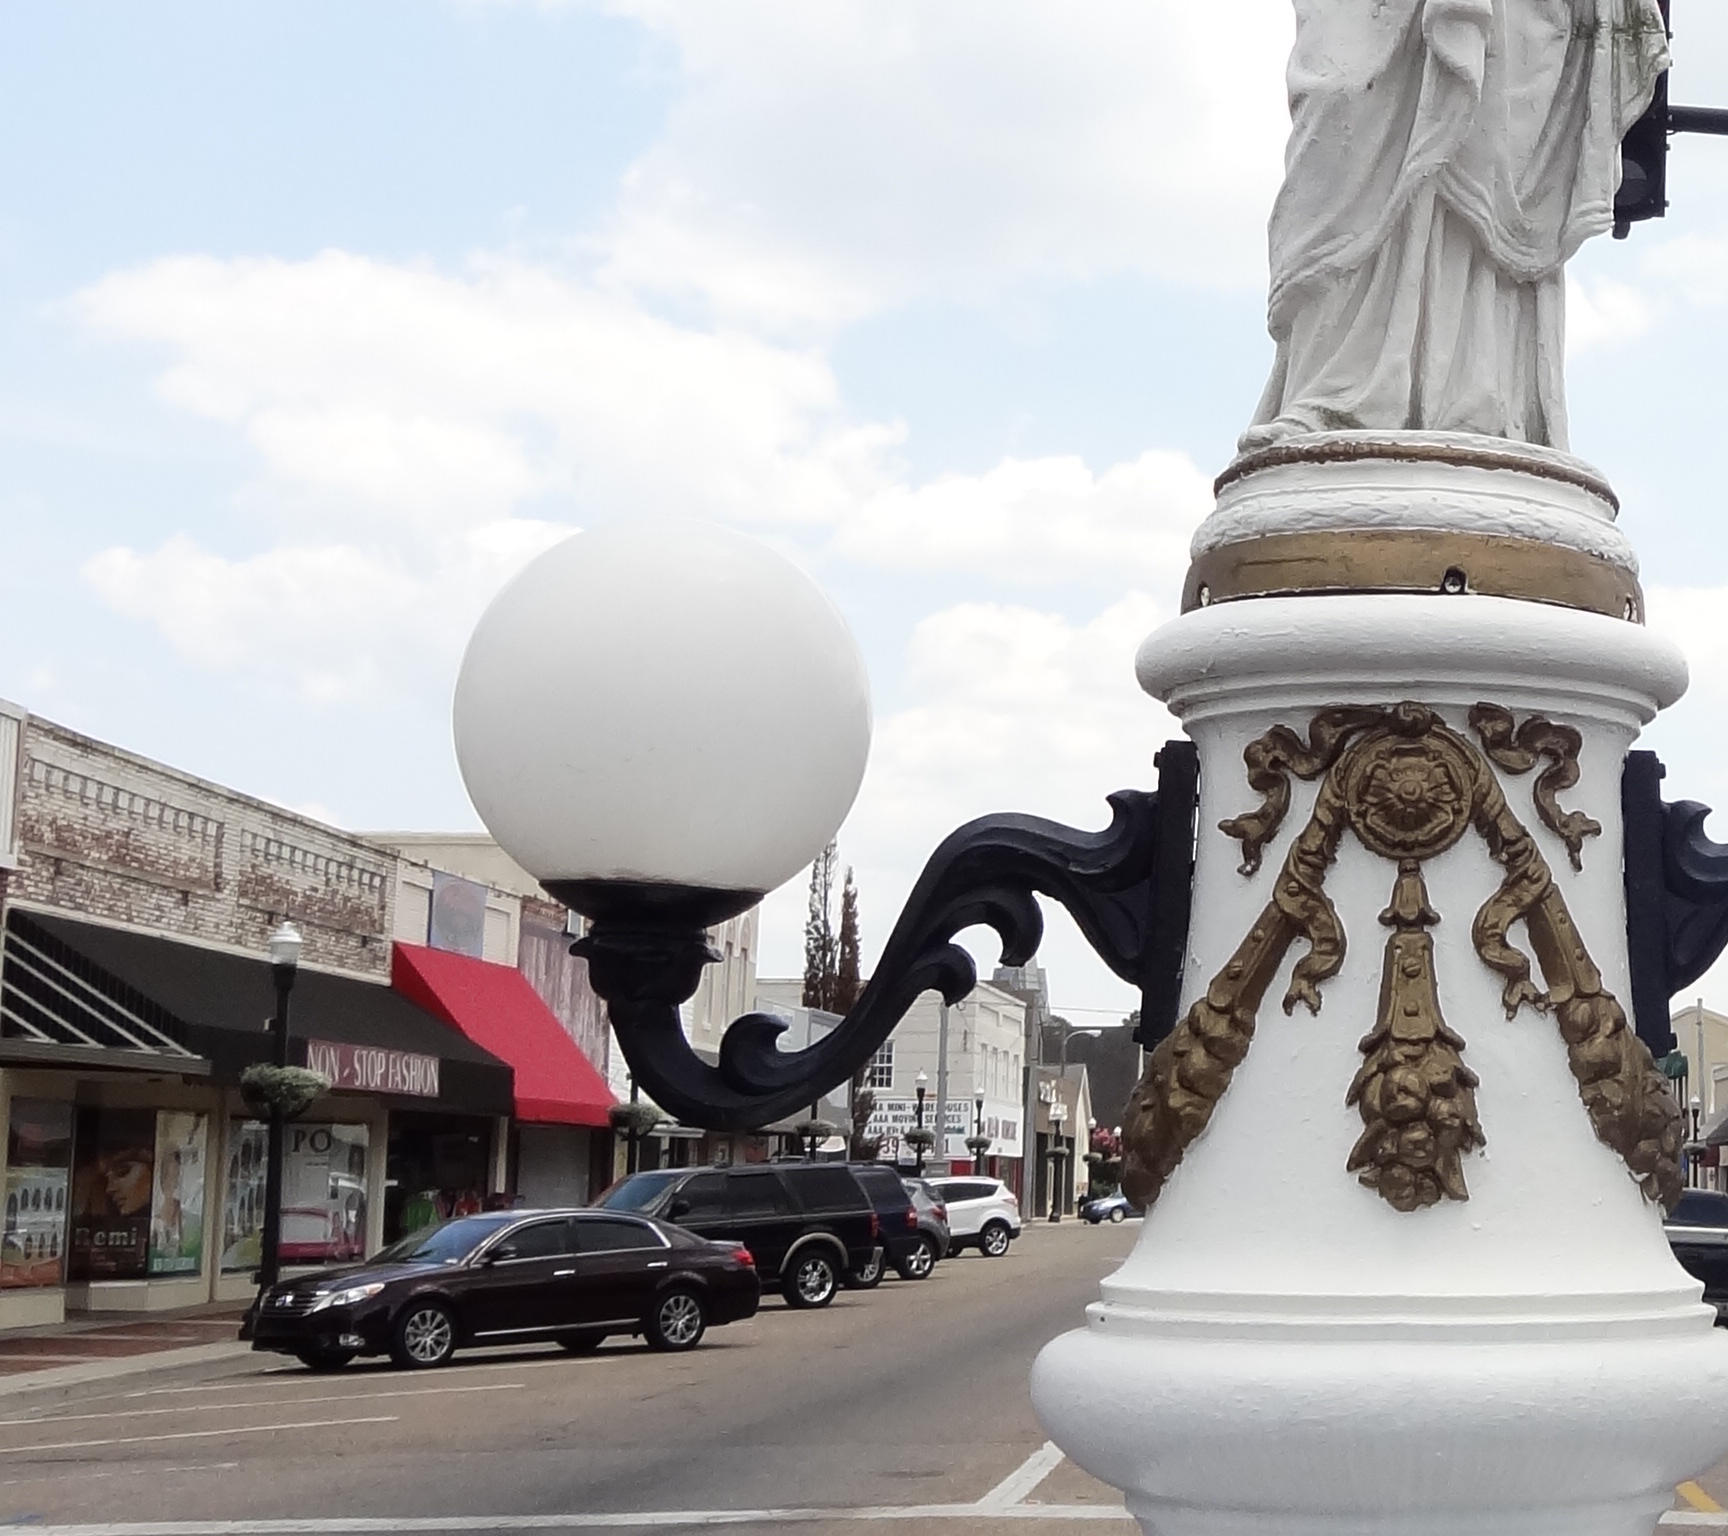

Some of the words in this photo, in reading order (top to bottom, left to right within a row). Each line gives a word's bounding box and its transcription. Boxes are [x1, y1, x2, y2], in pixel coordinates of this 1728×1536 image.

[307, 1044, 339, 1082] NON
[353, 1050, 386, 1087] STOP
[388, 1055, 440, 1093] FASHION
[74, 1227, 137, 1247] Remi
